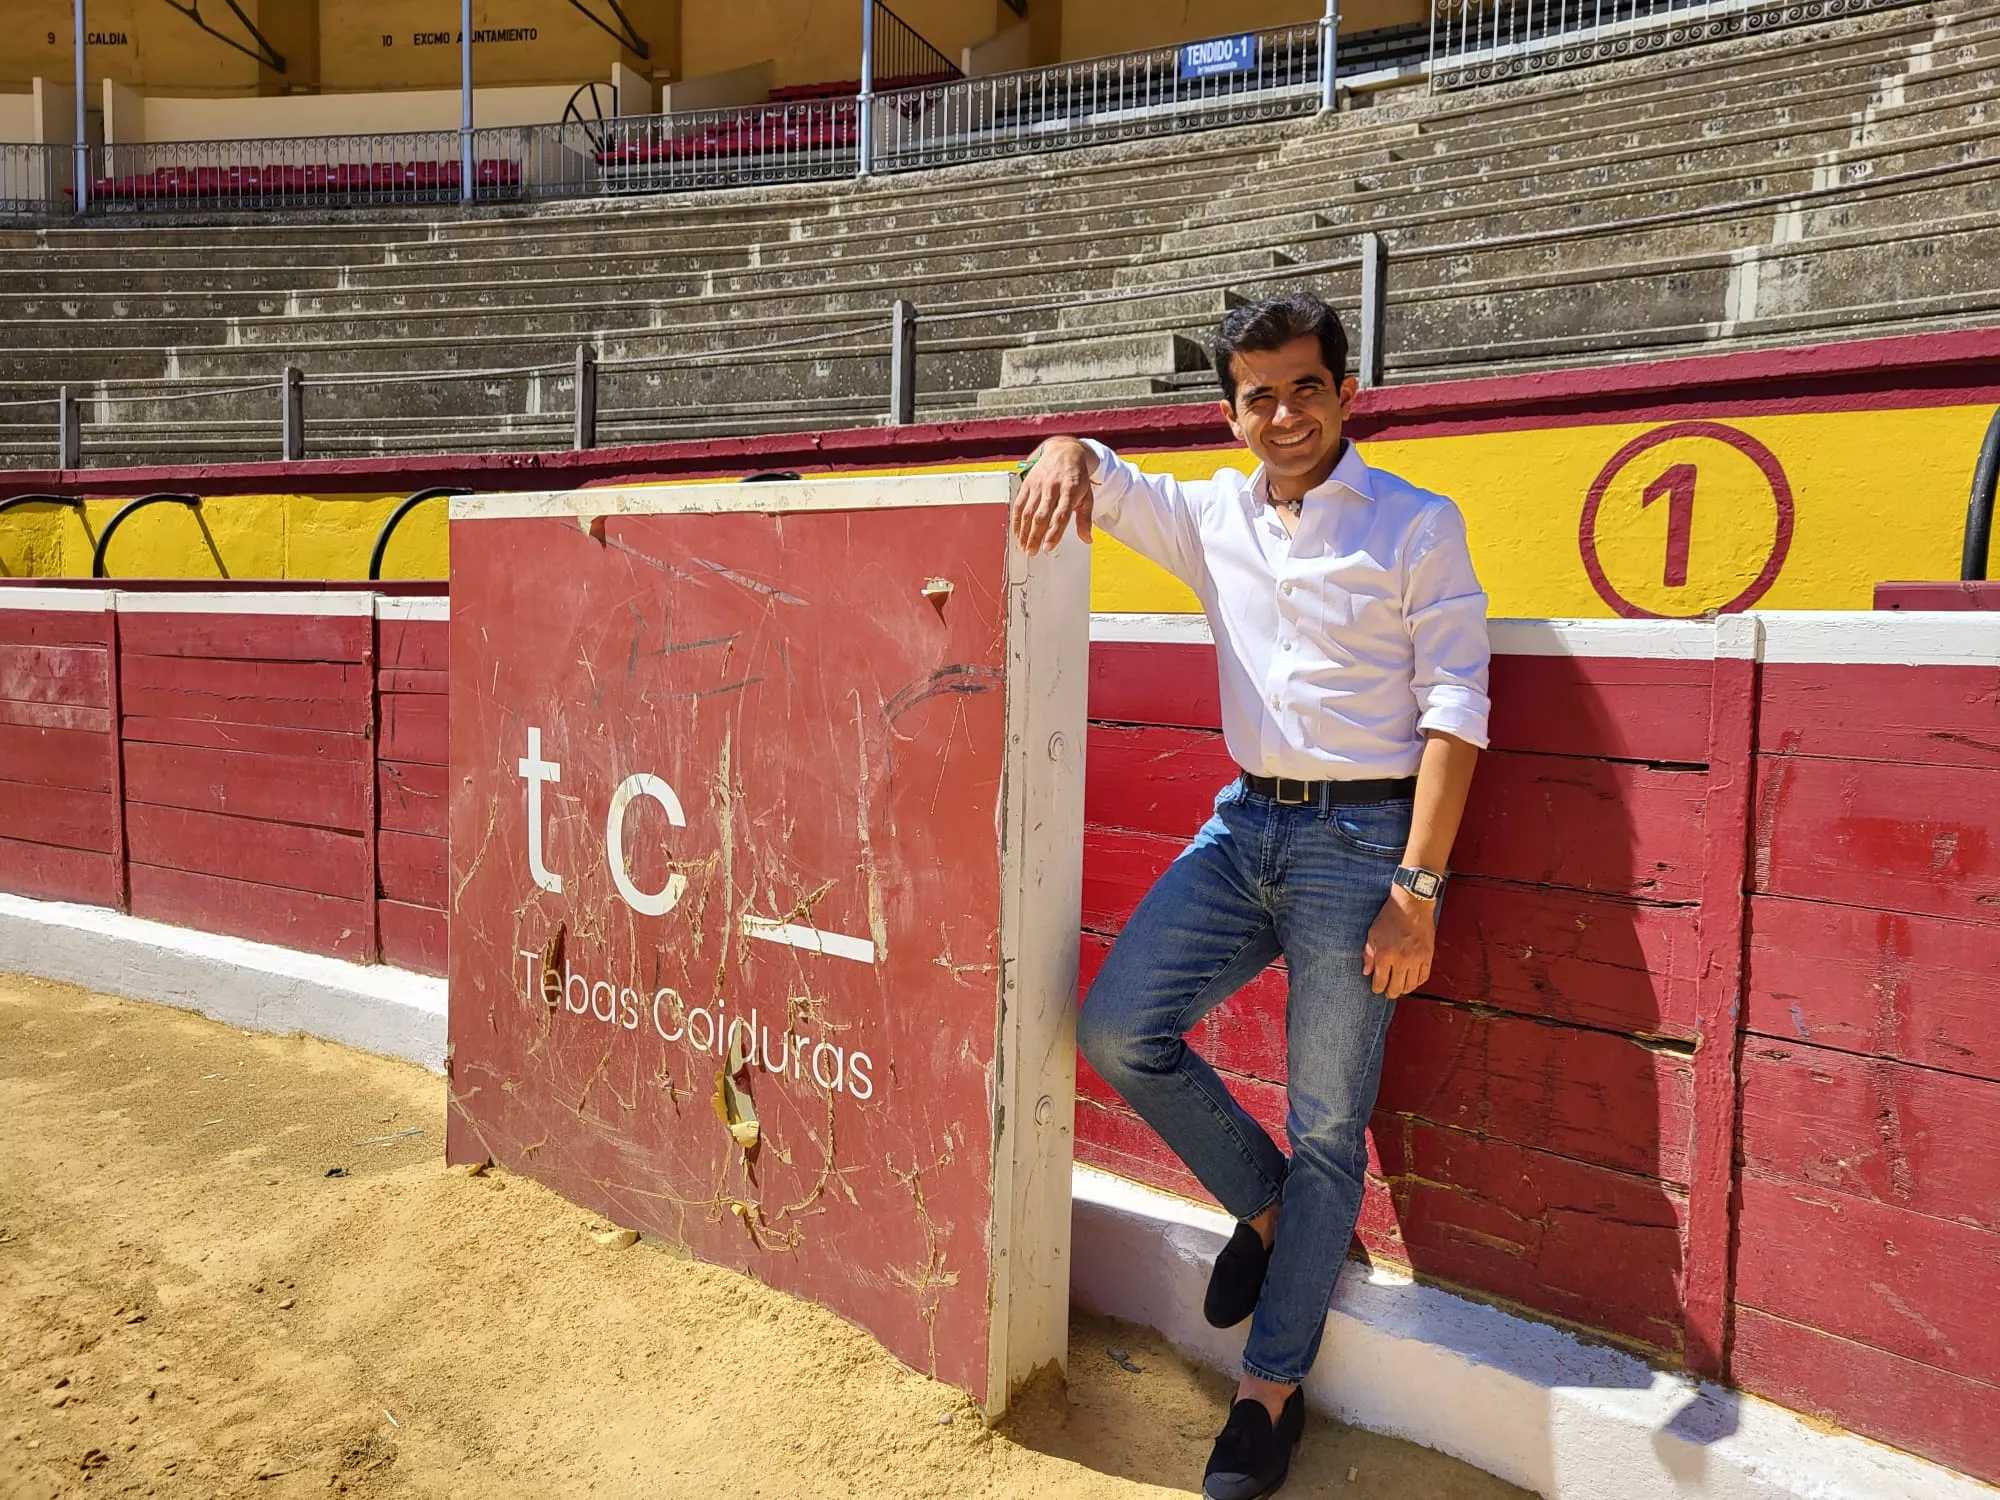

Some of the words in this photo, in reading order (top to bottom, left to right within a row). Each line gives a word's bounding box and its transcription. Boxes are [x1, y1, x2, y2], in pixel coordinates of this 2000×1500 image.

[47, 32, 56, 45] 9
[382, 35, 393, 48] 10
[413, 32, 450, 46] EXCMO
[456, 28, 538, 44] AUNTAMIENTO
[1187, 40, 1233, 66] TENDIDO
[1241, 36, 1248, 57] 1
[1641, 464, 1697, 587] 1
[519, 949, 639, 1030] Tebas
[653, 987, 873, 1100] Coiduras
